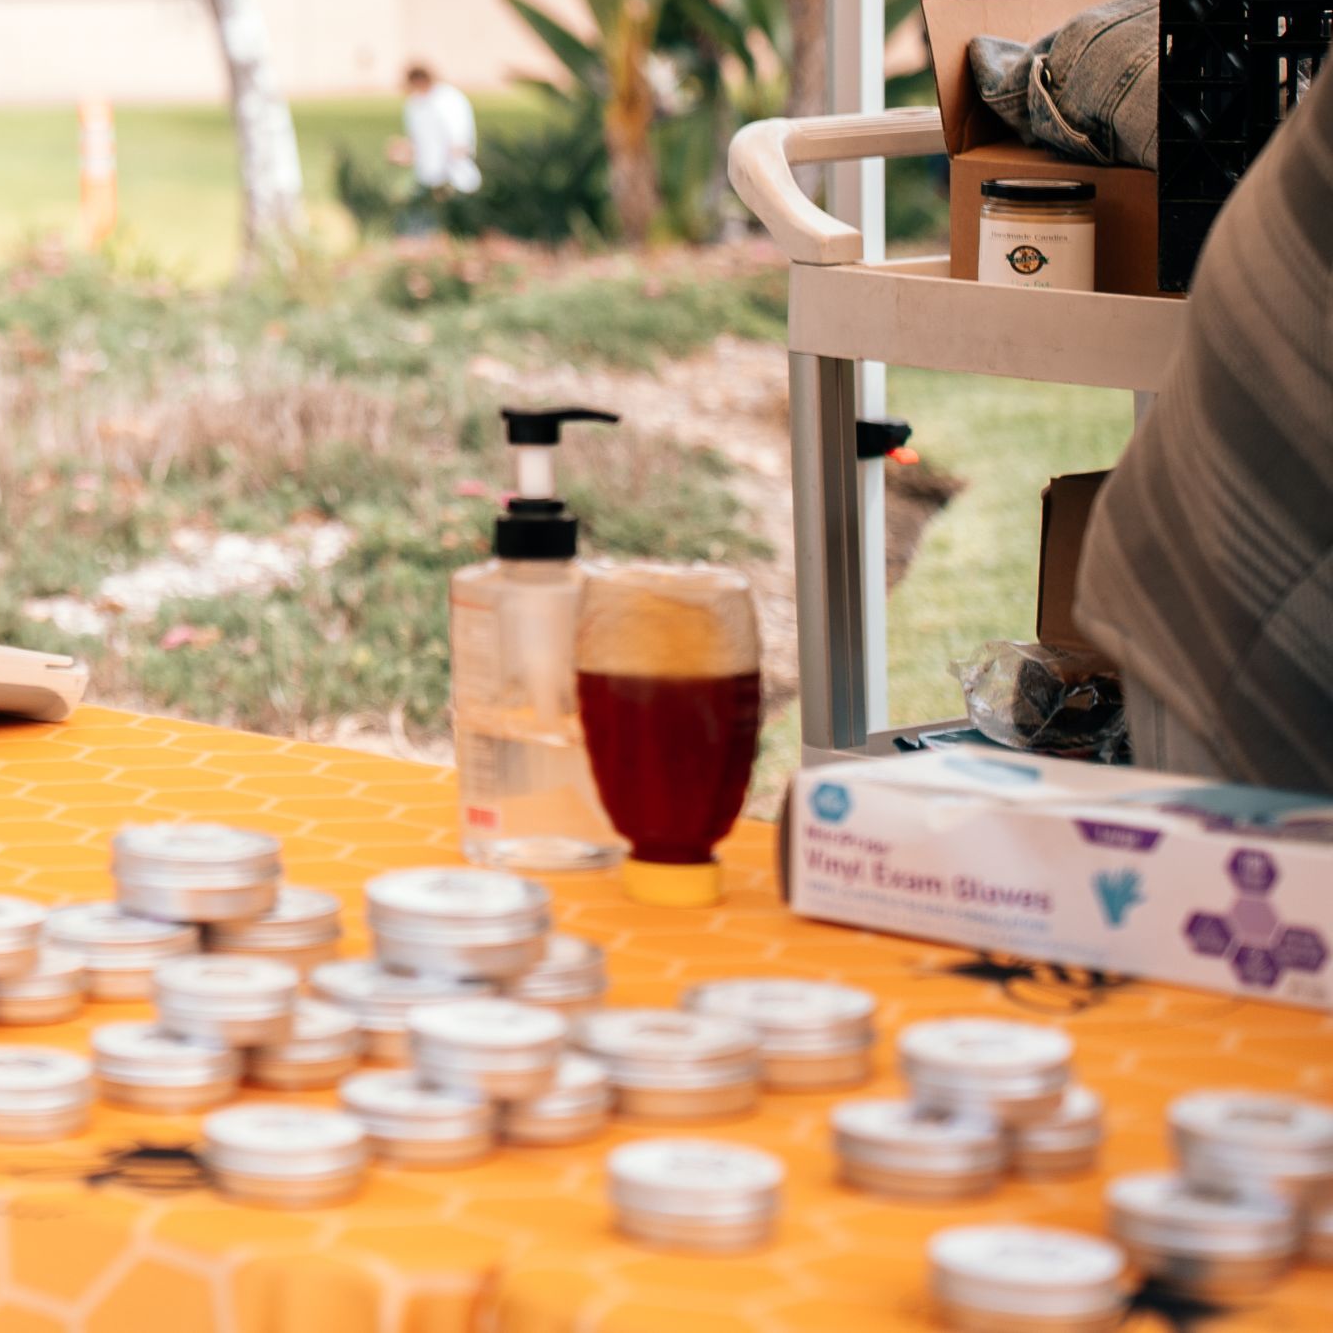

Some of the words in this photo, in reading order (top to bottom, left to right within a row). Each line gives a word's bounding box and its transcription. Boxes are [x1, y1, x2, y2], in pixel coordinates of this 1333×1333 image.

[805, 847, 862, 884] Vinyl
[871, 859, 944, 894] Exam
[953, 874, 1054, 914] Gloves
